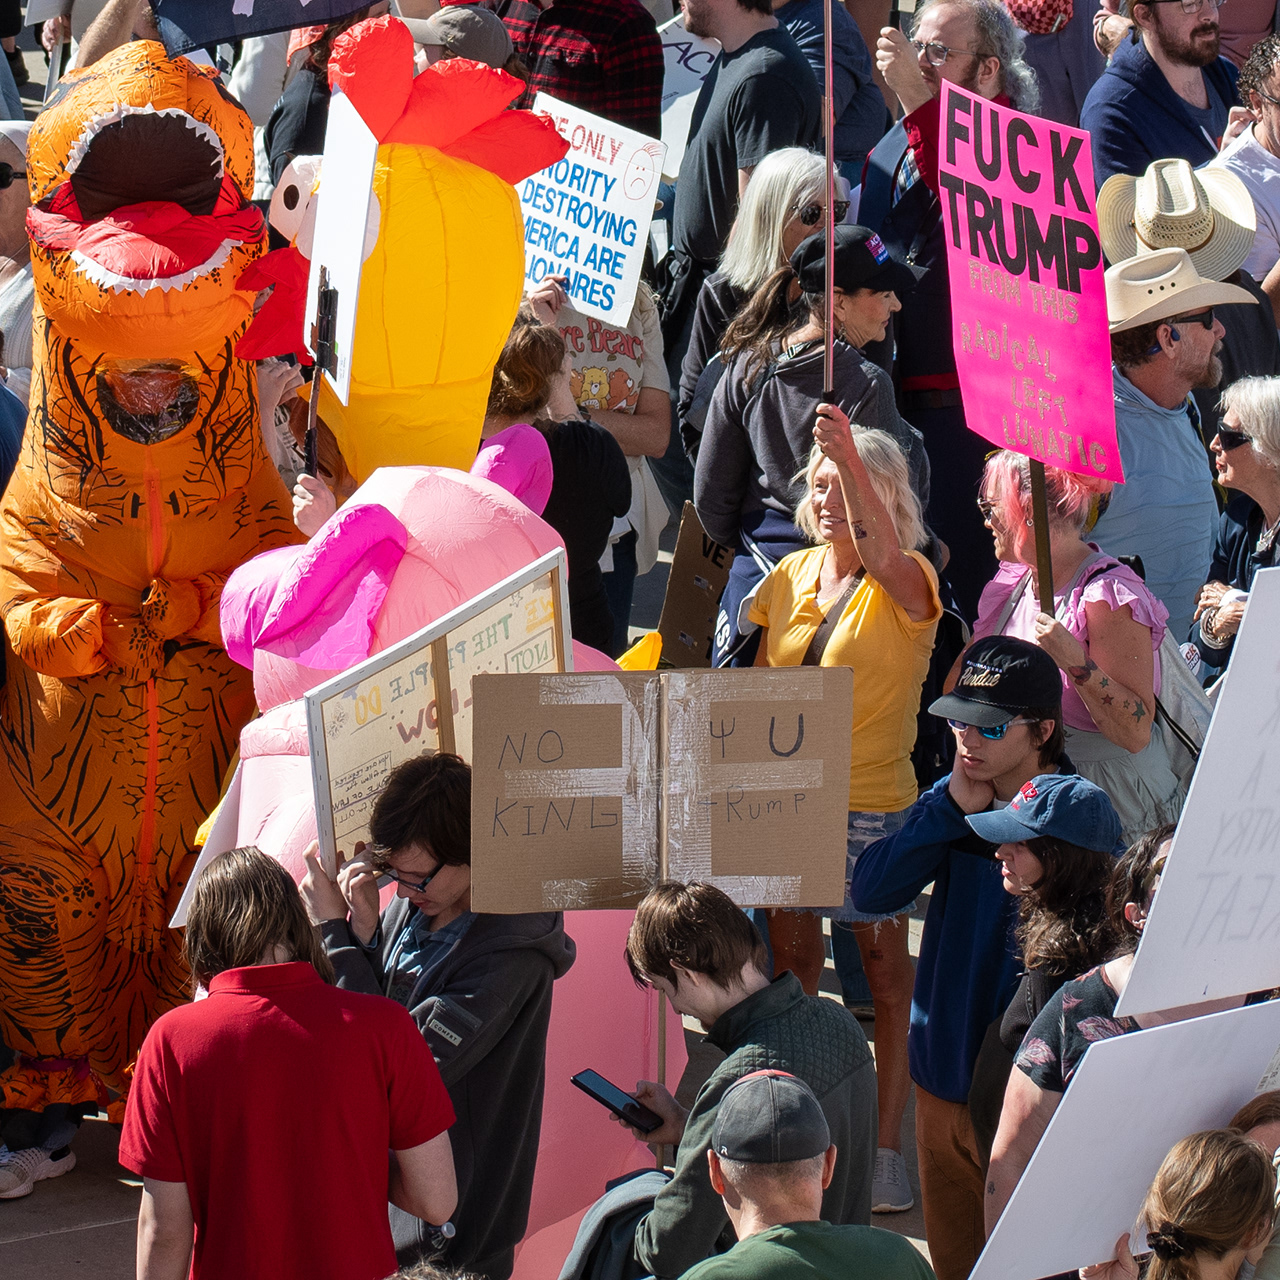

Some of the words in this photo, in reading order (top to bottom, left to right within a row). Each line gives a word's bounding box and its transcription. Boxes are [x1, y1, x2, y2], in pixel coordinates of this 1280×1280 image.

[946, 88, 1092, 215] FUCK
[939, 177, 1102, 295] TRUMP
[968, 257, 1021, 305] FROM
[1028, 281, 1080, 325] THIS
[960, 319, 1057, 383] RADICAL
[1011, 374, 1069, 428] LEFT
[1003, 411, 1108, 474] LUNATIC
